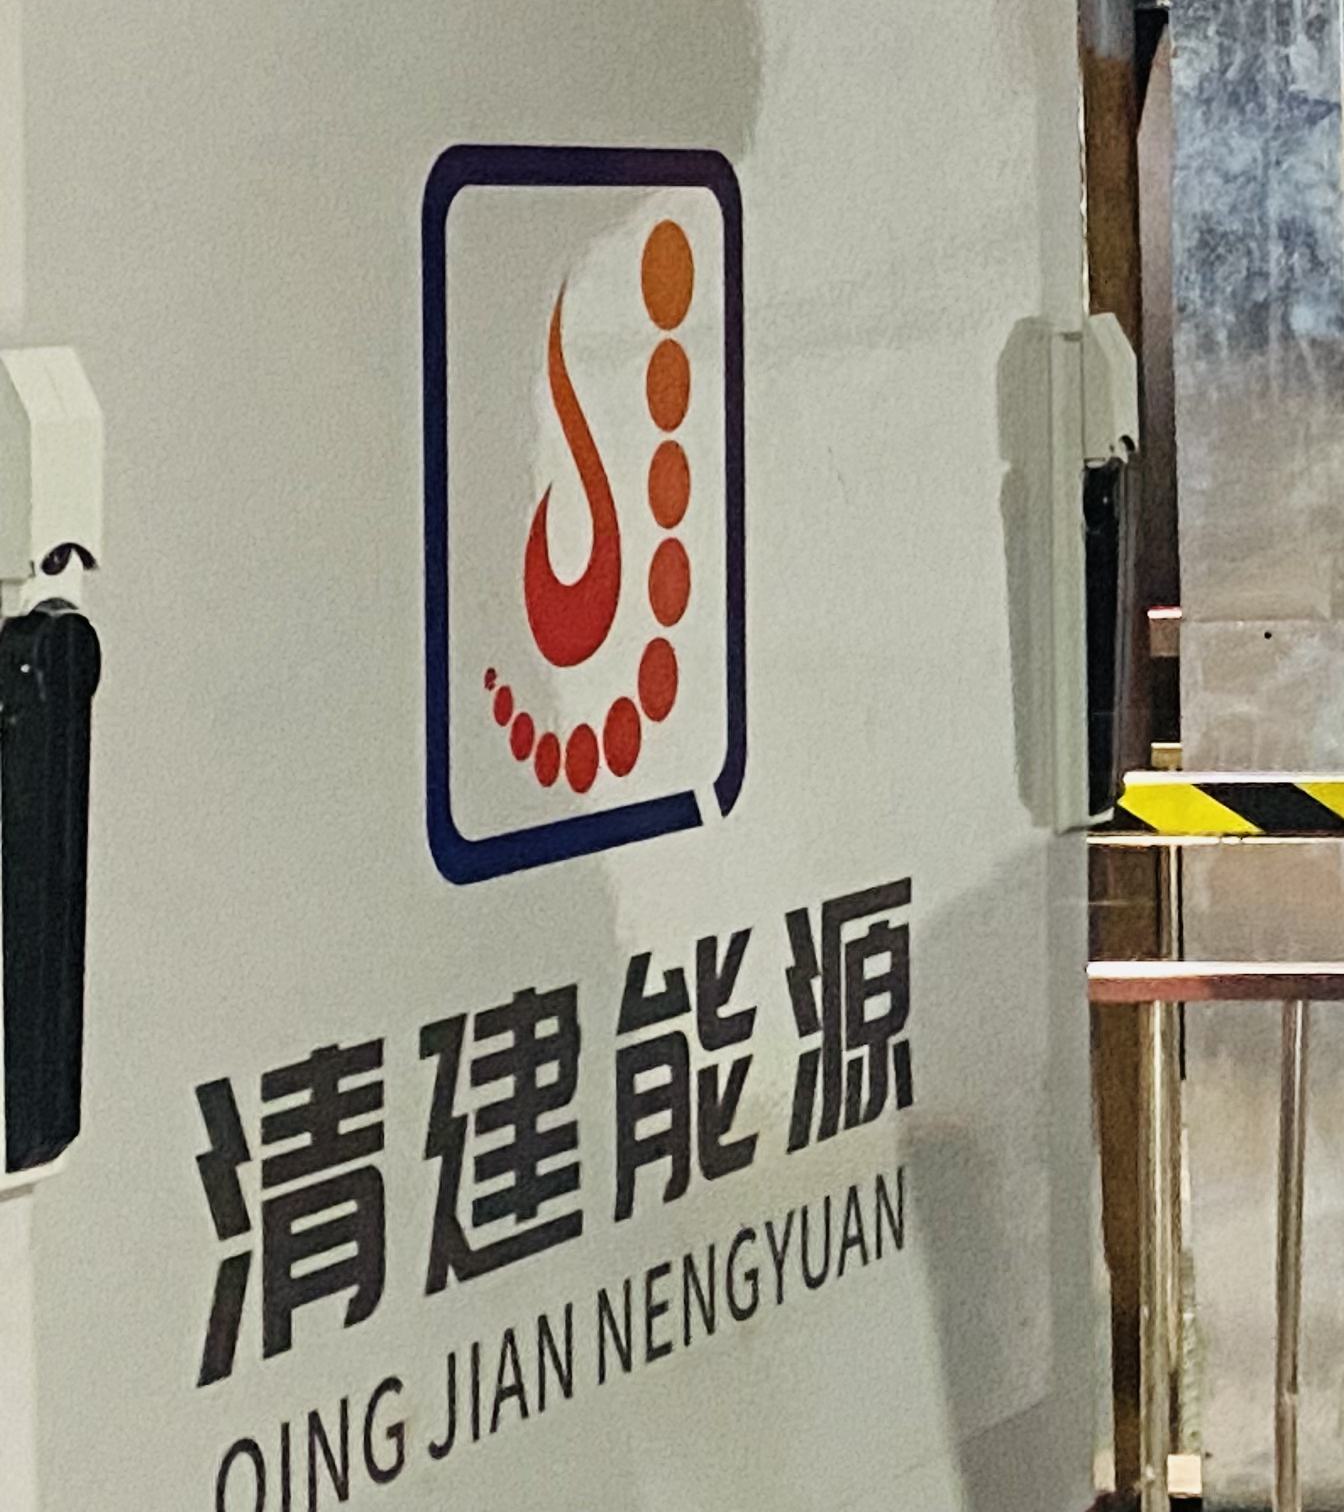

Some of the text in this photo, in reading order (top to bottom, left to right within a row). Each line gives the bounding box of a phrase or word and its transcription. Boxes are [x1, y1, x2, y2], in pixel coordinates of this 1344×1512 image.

[195, 876, 914, 1388] 清建能源
[427, 1302, 574, 1461] JIAN
[597, 1165, 907, 1385] NENGYUAN
